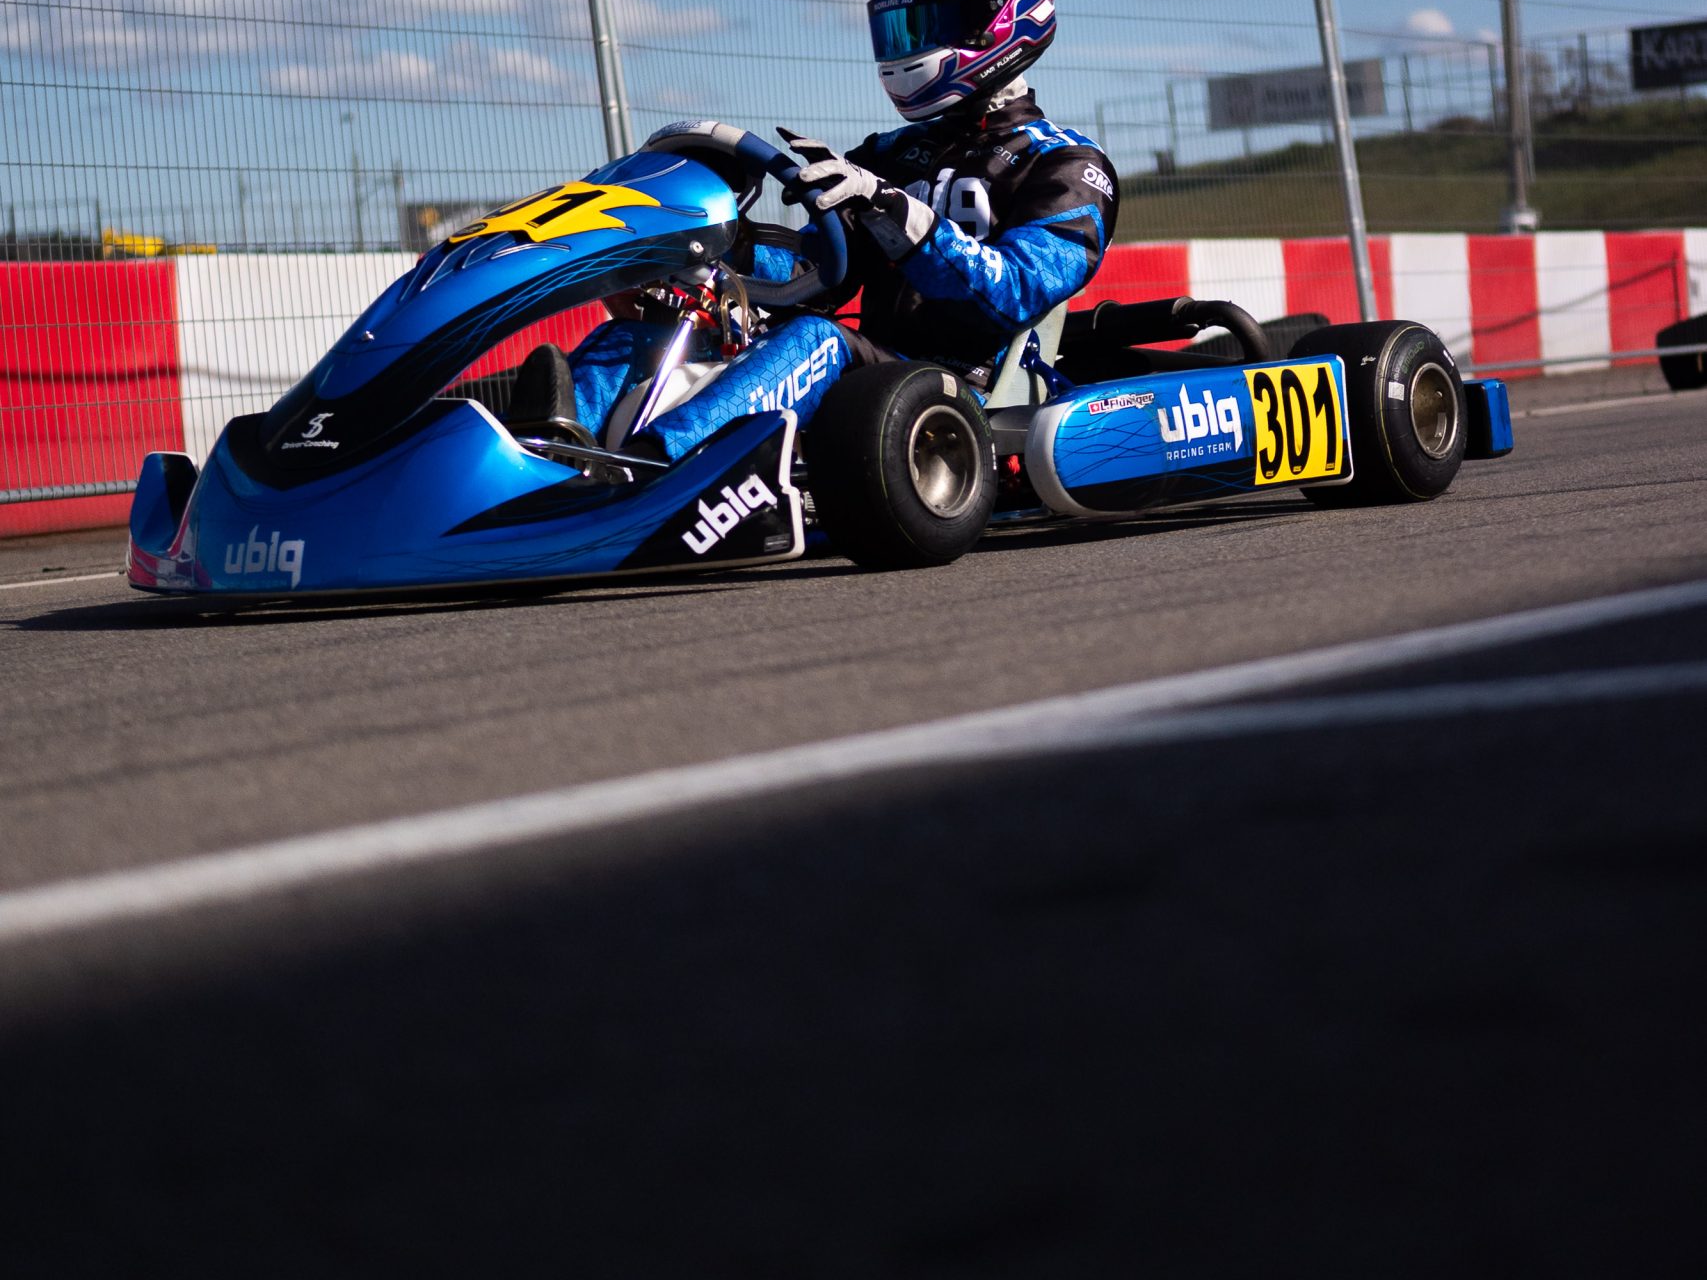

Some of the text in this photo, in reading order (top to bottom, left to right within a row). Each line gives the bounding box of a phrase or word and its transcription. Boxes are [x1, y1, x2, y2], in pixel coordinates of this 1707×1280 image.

[482, 185, 608, 229] 01
[1252, 366, 1338, 480] 301
[1166, 441, 1232, 461] RACING TEAM
